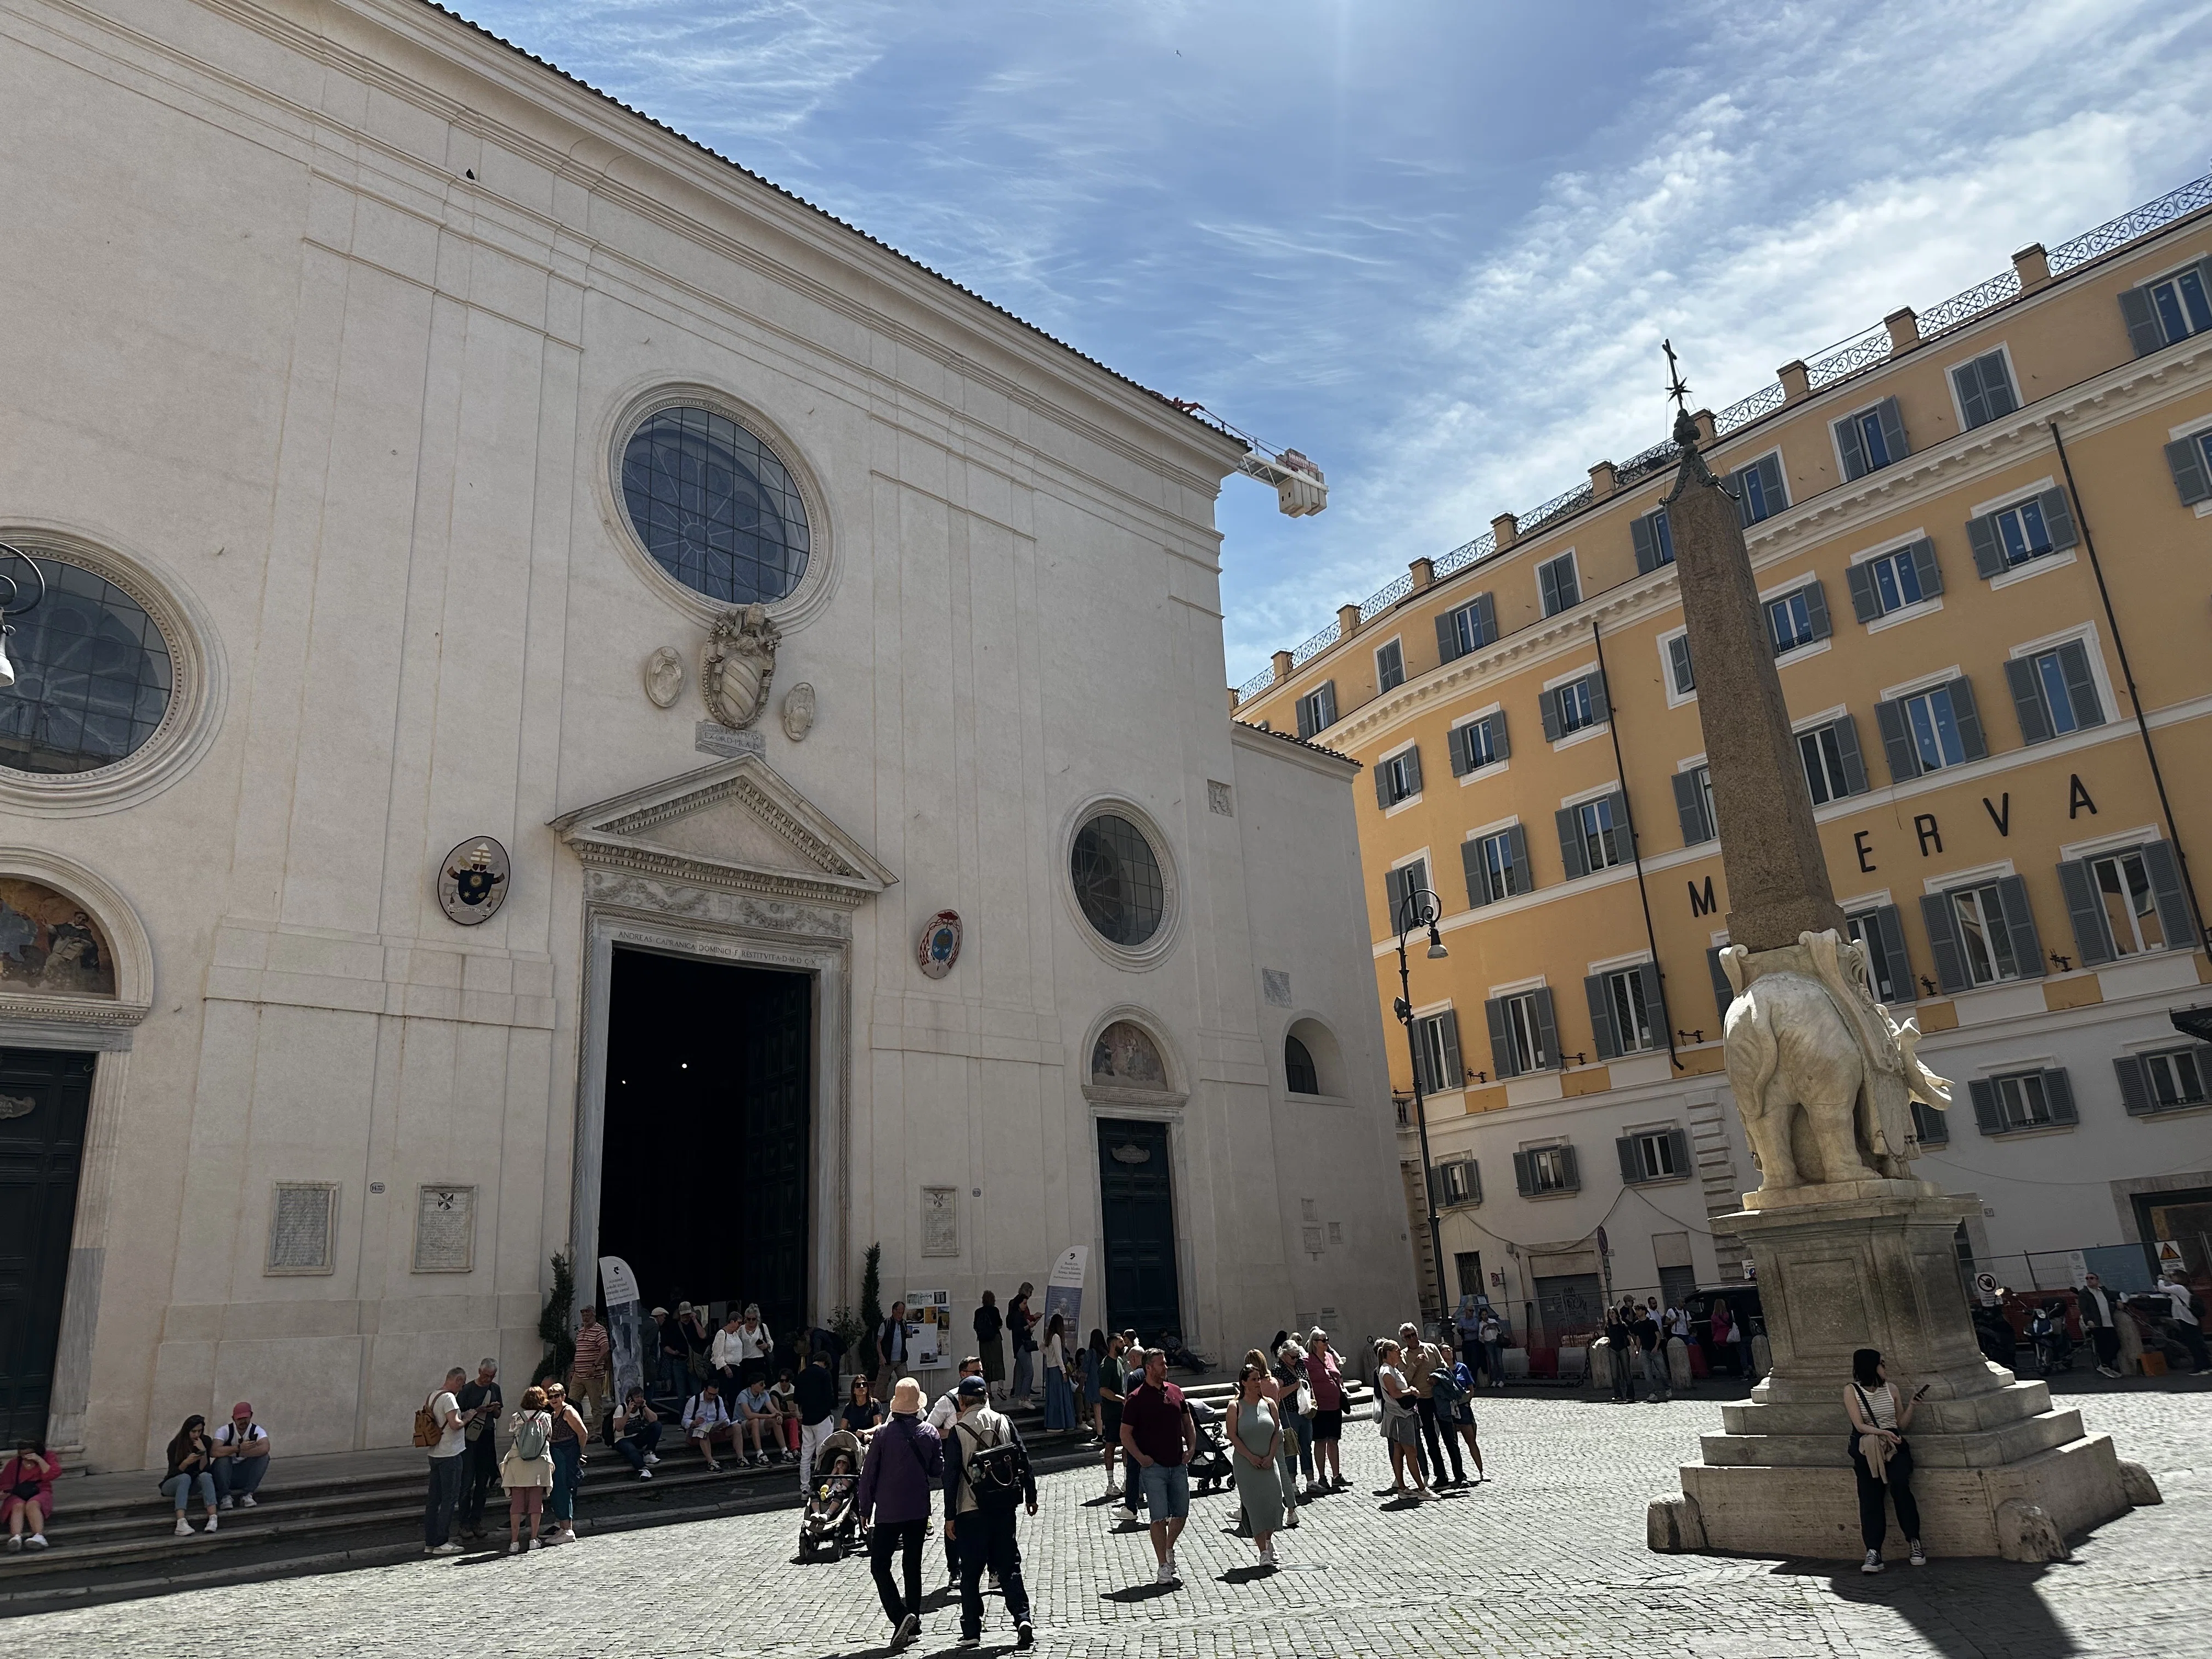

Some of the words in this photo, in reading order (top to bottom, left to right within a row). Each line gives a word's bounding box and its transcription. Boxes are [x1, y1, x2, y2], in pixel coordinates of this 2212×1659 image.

[1687, 774, 2098, 918] MERVA
[618, 931, 652, 942] ANDREAS
[656, 937, 696, 950] CAPRANICA
[698, 944, 732, 955] DOMINICI
